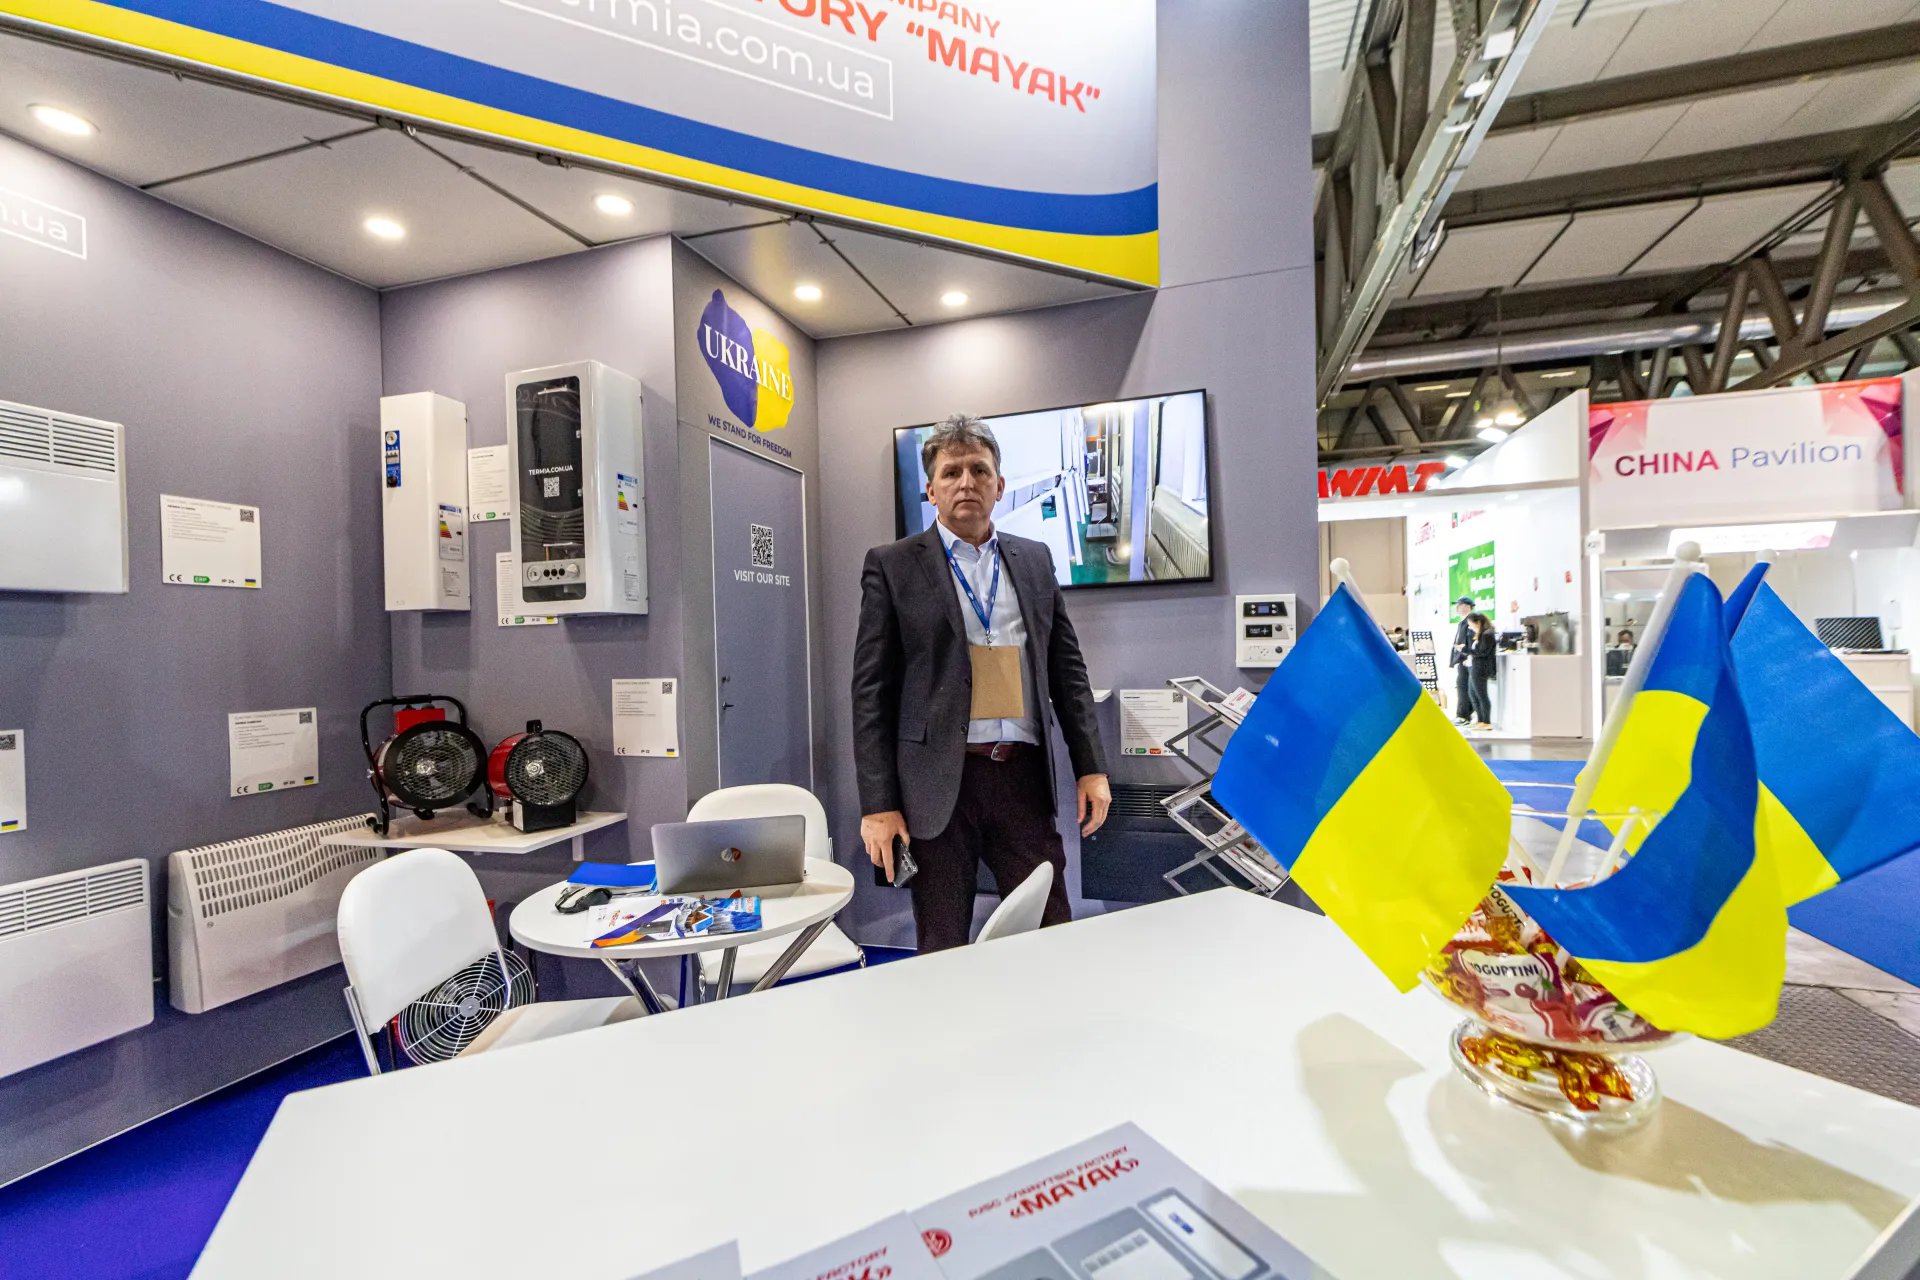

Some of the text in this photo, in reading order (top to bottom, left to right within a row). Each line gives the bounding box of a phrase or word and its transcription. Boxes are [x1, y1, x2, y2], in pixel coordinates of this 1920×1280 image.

[889, 0, 1001, 38] PANY
[560, 0, 876, 99] mia.com.ua
[704, 322, 792, 402] UKRAINE
[708, 413, 792, 459] WE STAND FOR FREEDOM
[528, 464, 574, 476] TERMIA.COM.UA
[1614, 440, 1863, 478] CHINA Pavilion
[733, 569, 791, 586] VISIT OUR SITE
[1010, 1157, 1140, 1220] «MAYAK»
